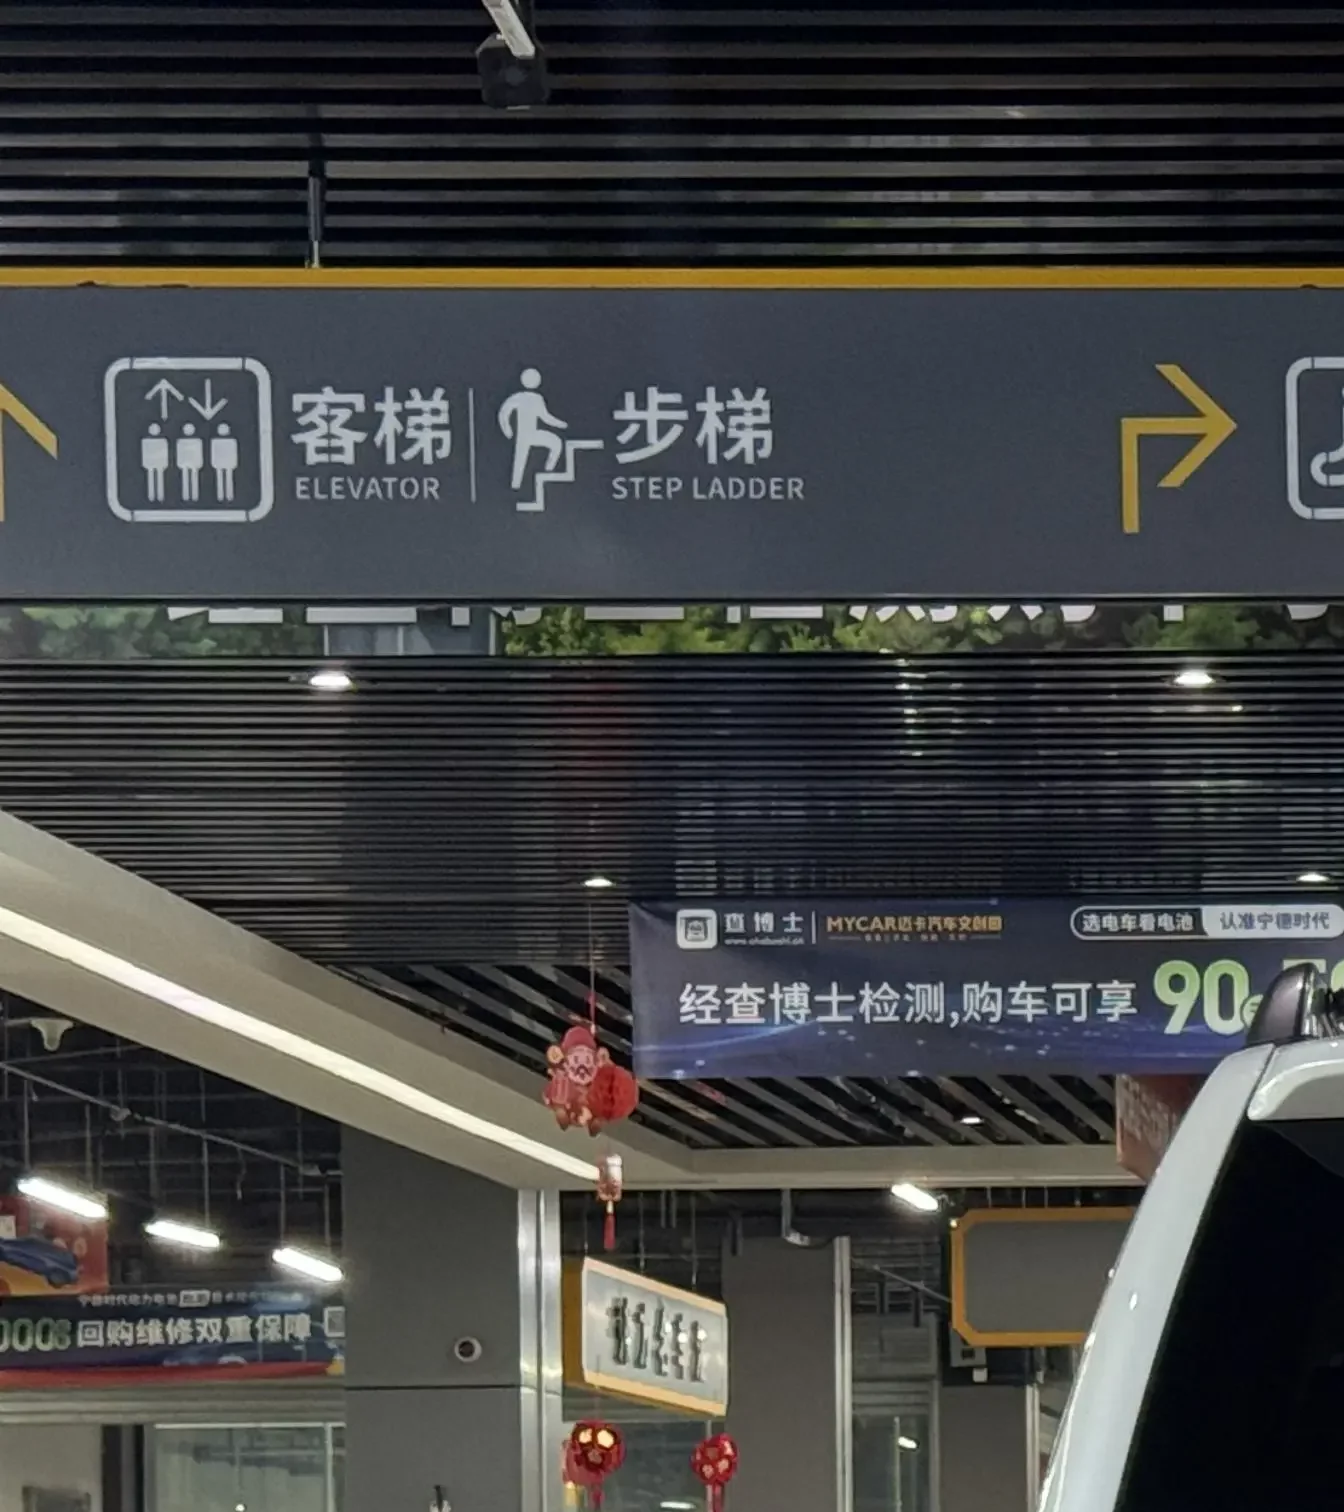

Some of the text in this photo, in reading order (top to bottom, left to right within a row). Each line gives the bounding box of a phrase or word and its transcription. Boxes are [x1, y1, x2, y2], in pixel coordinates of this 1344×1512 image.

[290, 385, 452, 465] 客梯
[611, 385, 774, 465] 步梯
[294, 475, 441, 501] ELEVATOR
[611, 475, 805, 501] STEP LADDER
[1219, 911, 1332, 932] 认准宁德时代
[678, 979, 1139, 1028] 经查博士检测,购车可享
[77, 1314, 312, 1348] 回购维修双重保障
